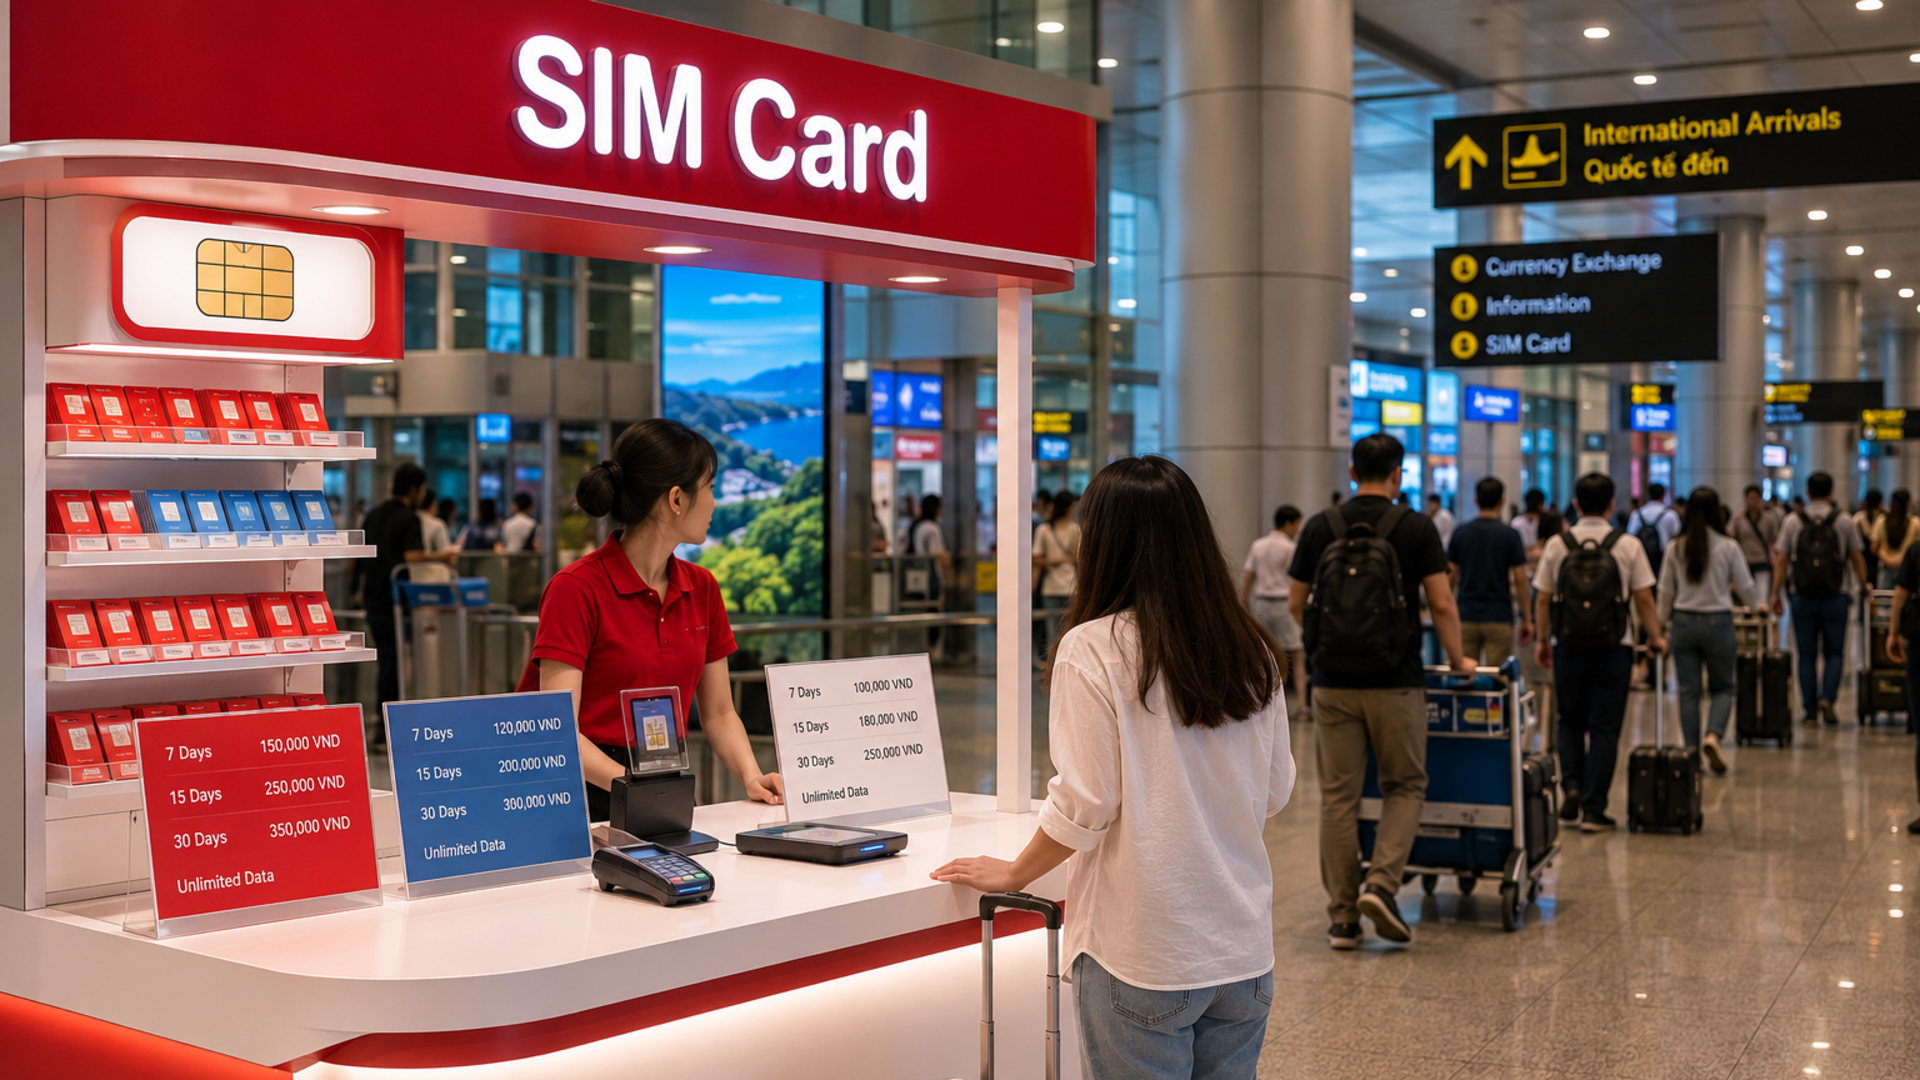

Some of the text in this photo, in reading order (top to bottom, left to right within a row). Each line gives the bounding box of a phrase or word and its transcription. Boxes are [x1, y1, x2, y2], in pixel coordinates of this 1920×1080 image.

[511, 34, 927, 203] SIM Card
[1583, 106, 1842, 147] International Arrivals
[1583, 152, 1647, 184] Quốc
[1485, 251, 1662, 278] Currency Exchange
[1486, 293, 1591, 316] Information
[1525, 332, 1571, 354] Card
[789, 678, 913, 700] 7 Days 100,000 VND
[412, 718, 561, 743] 7 Days 120,000 VND
[793, 710, 918, 734] 15 Days 180,000 VND
[165, 734, 340, 762] 7 Days 150,000 VND
[797, 743, 923, 769] 30 Days 250,000 VND
[416, 754, 566, 781] 15 Days 200,000 VND
[170, 775, 346, 805] 15 Days 250,000 VND
[802, 786, 869, 804] Unlimited Data
[420, 806, 435, 820] 30
[439, 805, 467, 820] Days
[547, 792, 571, 805] VND
[174, 816, 350, 849] 30 Days 350,000 VND
[424, 839, 506, 860] Unlimited Data
[177, 870, 275, 894] Unlimited Data
